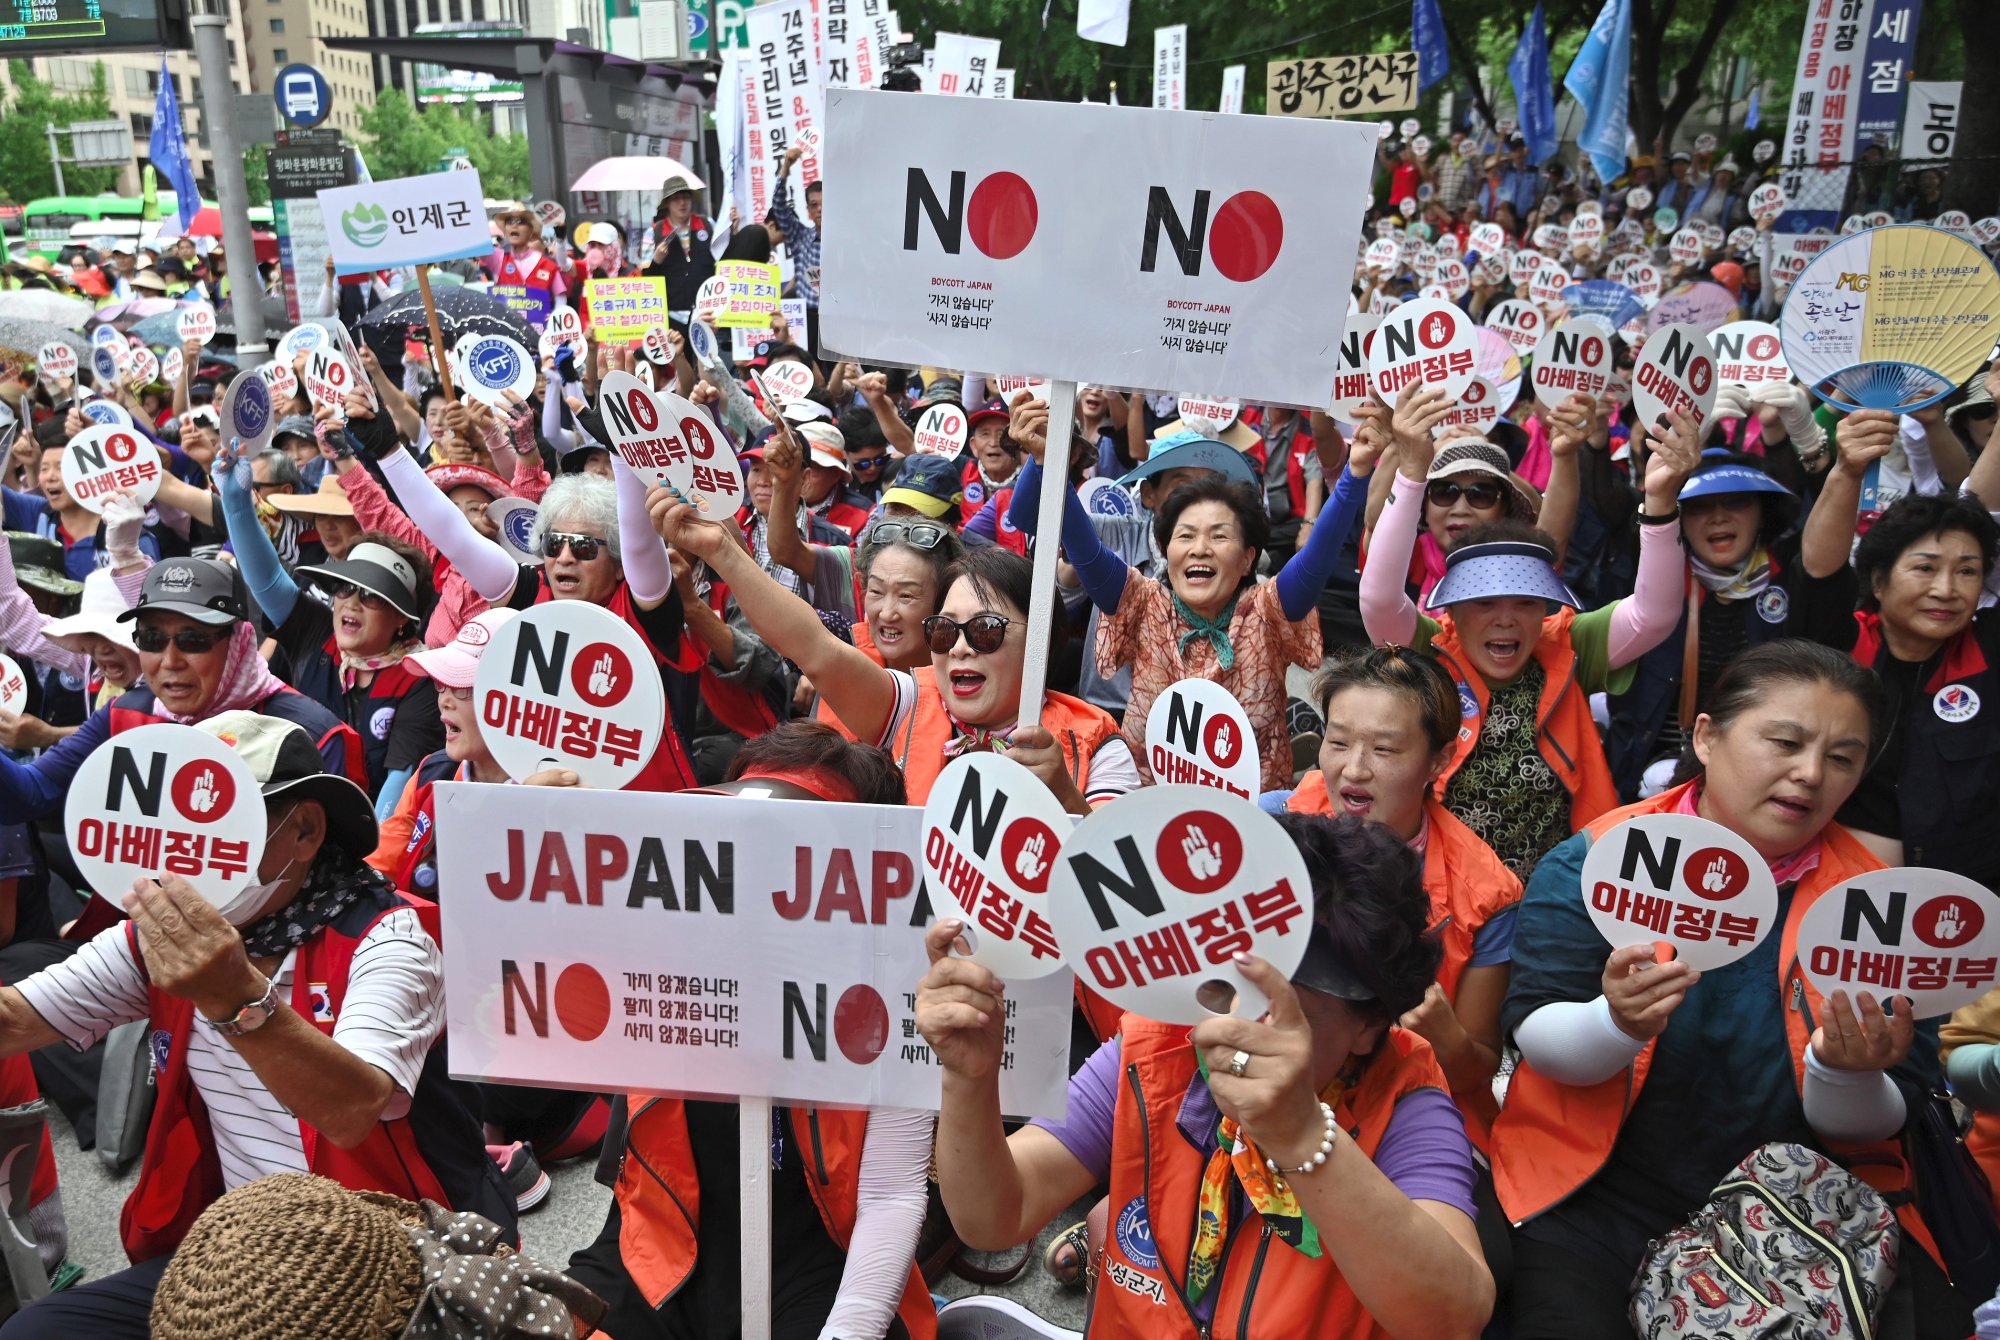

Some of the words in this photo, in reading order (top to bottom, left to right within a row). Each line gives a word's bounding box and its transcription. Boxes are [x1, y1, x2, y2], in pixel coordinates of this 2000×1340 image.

[760, 42, 784, 120] 우리는
[1271, 52, 1418, 113] 광주광산구
[1818, 65, 1850, 174] 아베정부
[1754, 188, 1778, 204] NO
[392, 201, 471, 234] 인제군
[903, 167, 1039, 260] NO
[1575, 217, 1596, 229] NO
[1140, 185, 1284, 283] NO
[1676, 234, 1697, 247] NO
[735, 266, 769, 280] 정부는
[1438, 264, 1460, 280] NO
[1516, 256, 1540, 269] NO
[1627, 268, 1652, 285] NO
[1779, 255, 1805, 270] NO
[1880, 270, 1895, 279] MG
[594, 283, 616, 296] 일본
[621, 282, 653, 294] 정부는
[703, 281, 725, 297] NO
[753, 285, 776, 298] 조치
[931, 277, 965, 290] BOYCOTT
[966, 280, 992, 291] JAPAN
[1538, 270, 1565, 288] NO
[1835, 272, 1871, 292] MG
[184, 312, 208, 325] NO
[593, 299, 637, 311] 수출규제
[641, 298, 662, 309] 조치
[1167, 299, 1202, 312] BOYCOTT
[1204, 302, 1231, 315] JAPAN
[1500, 305, 1537, 330] NO
[552, 313, 574, 332] NO
[1875, 317, 1890, 326] MG
[1384, 311, 1455, 362] NO
[1552, 331, 1603, 367] NO
[1715, 333, 1780, 362] NO
[44, 346, 68, 359] NO
[479, 354, 510, 376] KFF
[1659, 329, 1712, 396] NO
[264, 365, 286, 384] NO
[313, 353, 345, 386] NO
[776, 364, 808, 386] NO
[1379, 349, 1474, 394] 아베정부
[1535, 366, 1605, 394] 아베정부
[240, 393, 264, 420] KFF
[604, 388, 659, 437] NO
[1181, 400, 1233, 421] 아베정부
[926, 410, 960, 435] NO
[72, 433, 137, 474] NO
[618, 434, 687, 471] 아베정부
[917, 431, 960, 454] 아베정부
[74, 460, 158, 500] 아베정부
[510, 620, 633, 707] NO
[483, 689, 643, 768] 아베정부
[1166, 690, 1243, 768] NO
[105, 745, 236, 823] NO
[949, 765, 1063, 893] NO
[77, 817, 250, 880] 아베정부
[485, 829, 734, 914] JAPAN
[772, 846, 930, 928] JAP
[1068, 809, 1243, 932] NO
[1619, 827, 1750, 901] NO
[925, 825, 1062, 960] 아베정부
[1591, 881, 1760, 947] 아베정부
[1840, 887, 1985, 949] NO
[1084, 877, 1303, 989] 아베정부
[1810, 945, 1998, 990] 아베정부
[623, 972, 652, 992] 가지
[658, 974, 739, 998] 않겠습니다!
[501, 959, 611, 1042] NO
[623, 997, 653, 1018] 팔지
[658, 999, 739, 1023] 않겠습니다!
[623, 1022, 653, 1042] 사지
[658, 1024, 739, 1048] 않겠습니다!
[783, 981, 889, 1065] NO
[901, 1044, 930, 1065] 사지
[1117, 1211, 1128, 1240] KOREA
[1117, 1238, 1150, 1269] FREEDOM
[1106, 1254, 1166, 1305] 성군지
